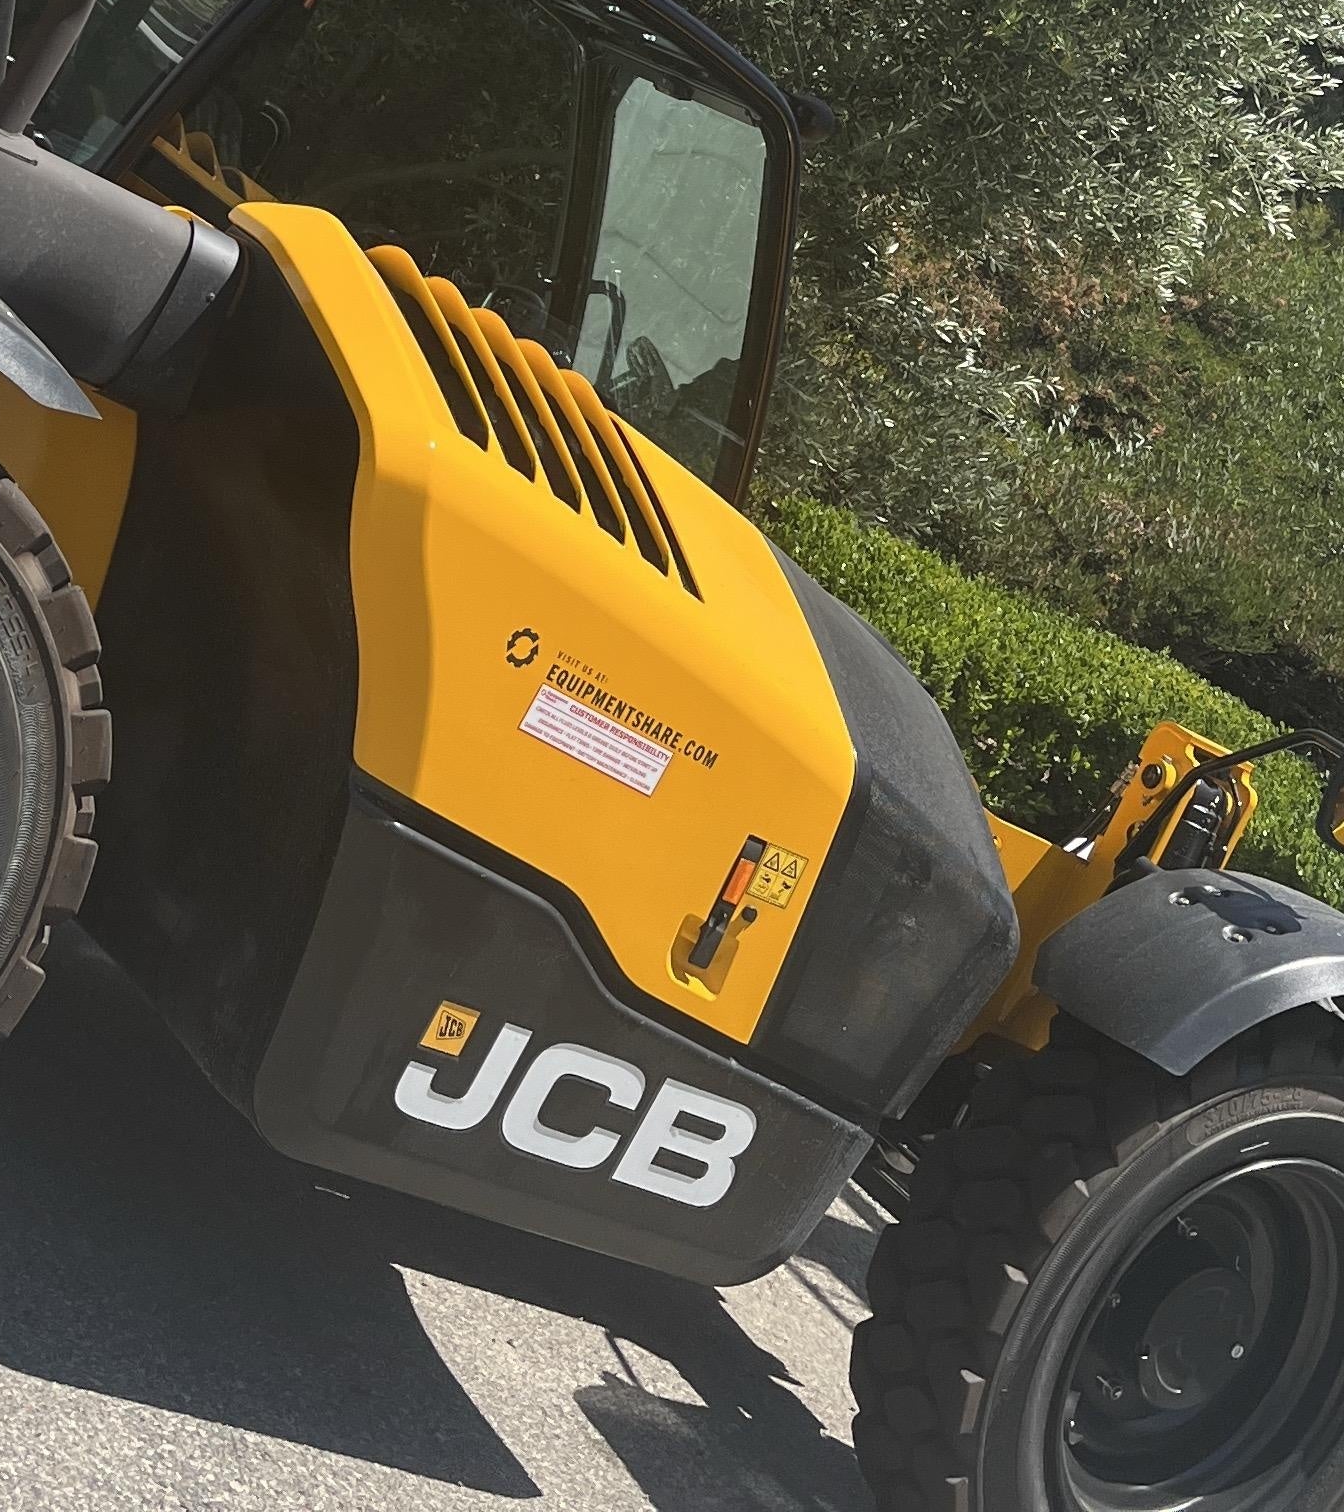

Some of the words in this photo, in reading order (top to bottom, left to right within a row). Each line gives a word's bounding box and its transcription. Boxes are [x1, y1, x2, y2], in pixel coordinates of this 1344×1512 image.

[557, 650, 581, 669] VISIT
[582, 663, 594, 676] US
[545, 663, 720, 770] EQUIPMENTSHARE.COM
[438, 1014, 464, 1038] JCB
[393, 1022, 758, 1208] JCB
